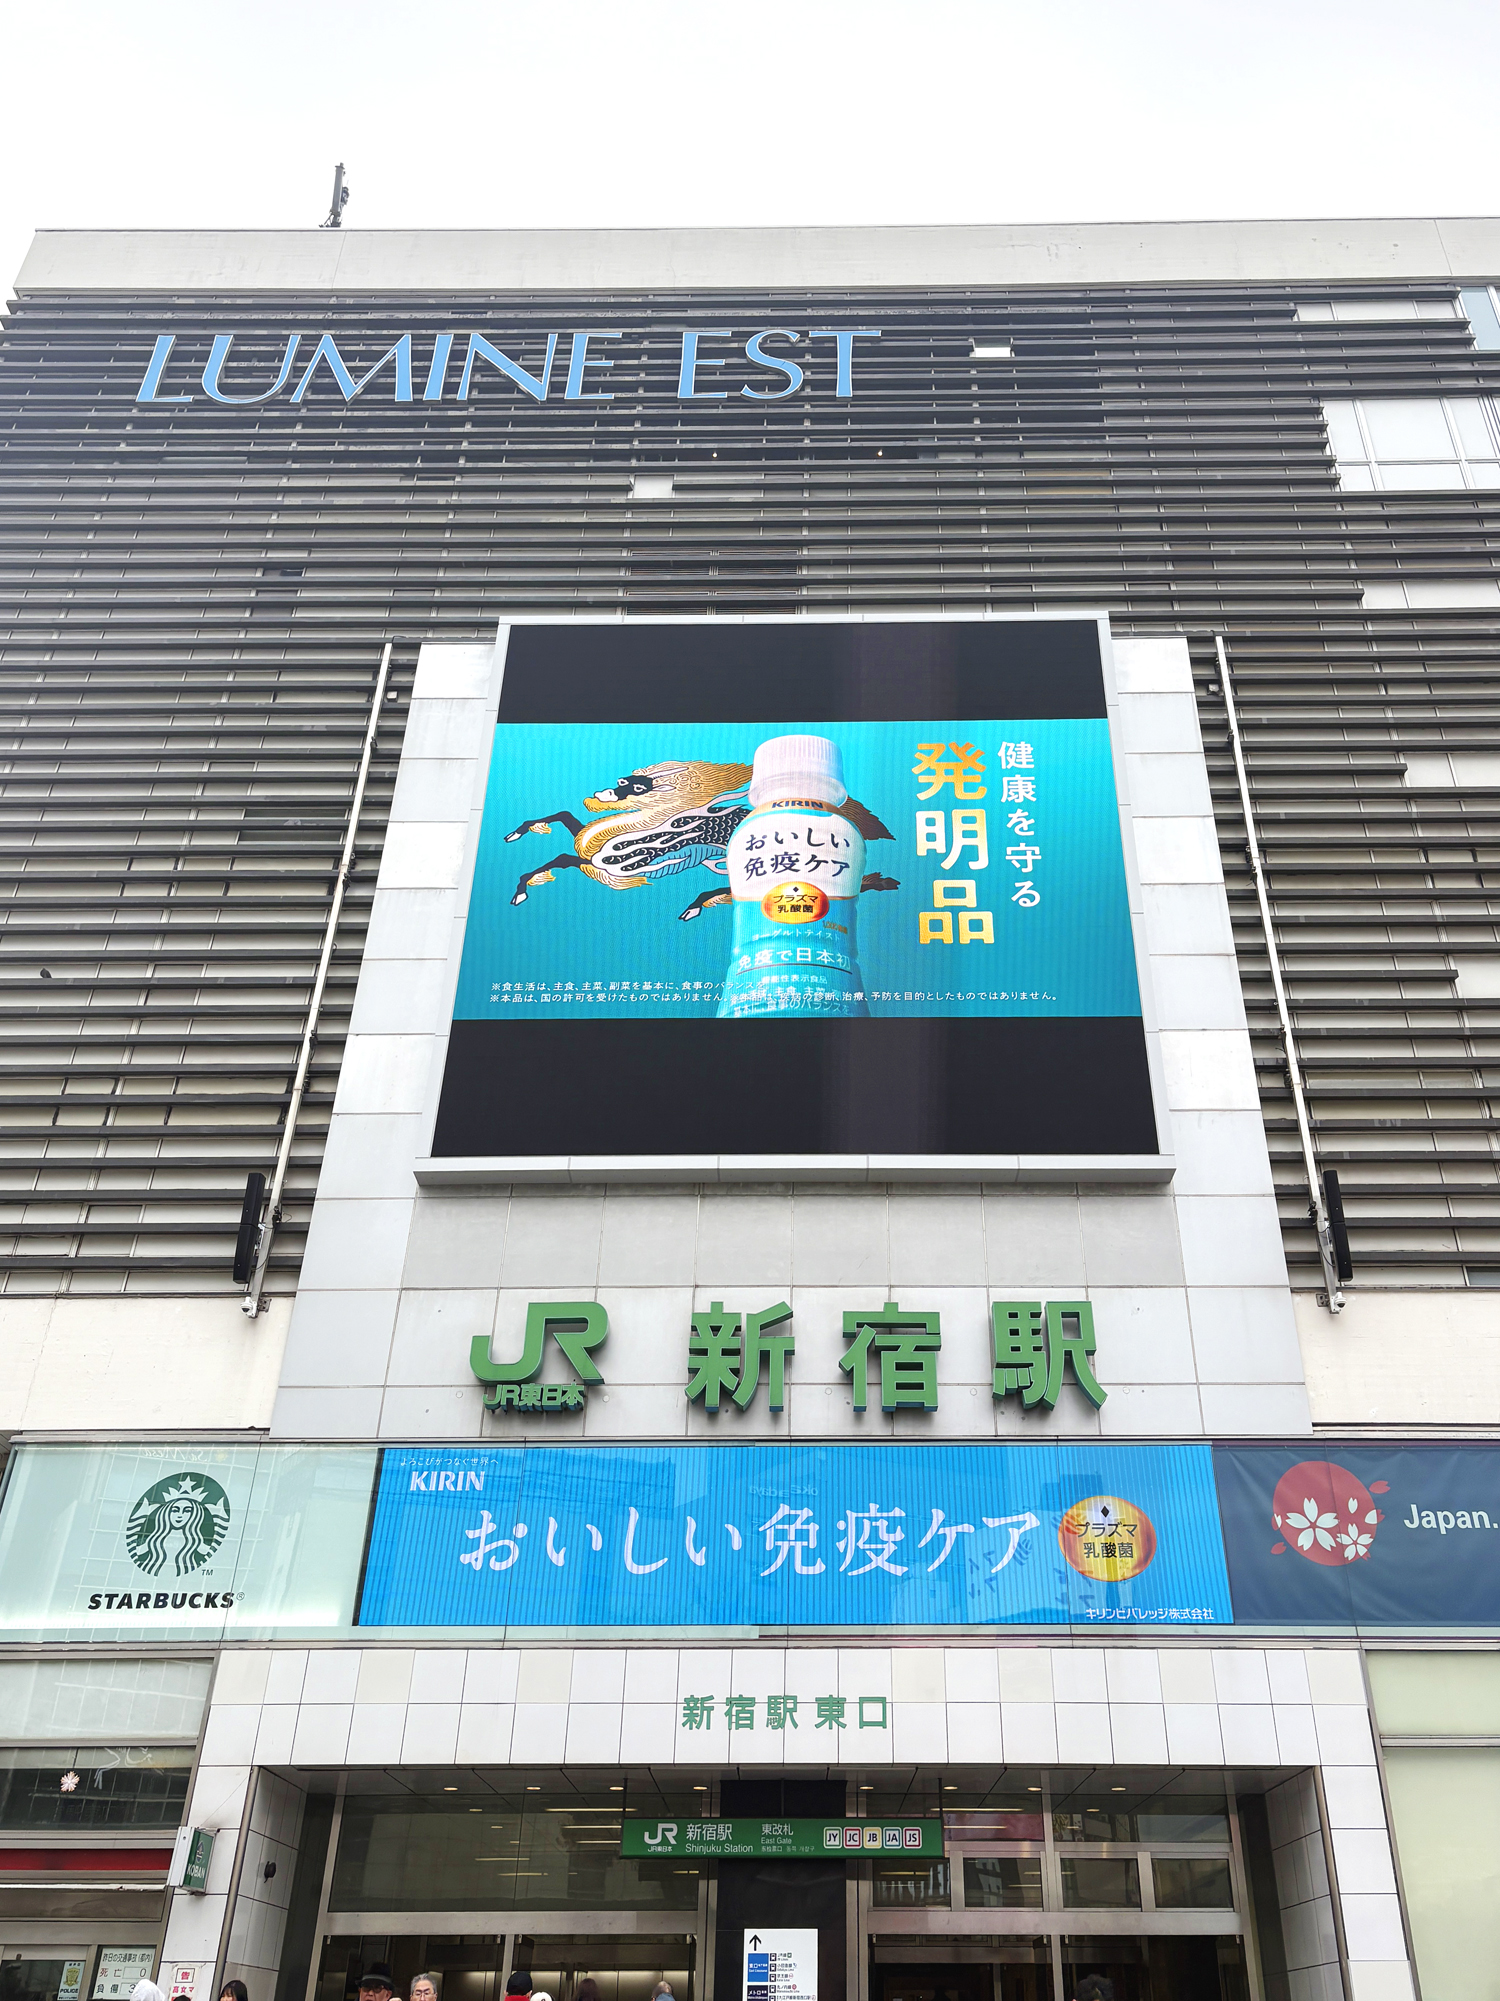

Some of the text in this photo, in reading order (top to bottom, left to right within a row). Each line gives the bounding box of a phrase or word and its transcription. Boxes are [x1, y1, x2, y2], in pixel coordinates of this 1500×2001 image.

[135, 329, 882, 405] LUMINE EST
[771, 800, 824, 809] KIRIN
[997, 741, 1042, 908] 健康を守る
[745, 827, 850, 851] おいしい
[911, 741, 995, 945] 発明品
[743, 851, 850, 882] 免疫ケア
[773, 894, 819, 903] プラズマ
[777, 904, 814, 914] 乳酸菌
[737, 947, 850, 971] 免疫で日本初
[469, 1301, 610, 1385] JR
[684, 1301, 1109, 1413] 新宿駅
[483, 1383, 587, 1413] JR東日本
[400, 1456, 499, 1467] よろこびがつなぐ世界へ
[410, 1471, 486, 1491] KIRIN
[1403, 1503, 1499, 1535] Japan.
[1077, 1521, 1138, 1539] プラズマ
[459, 1503, 1040, 1576] おいしい免疫ケア
[1083, 1541, 1135, 1560] 乳酸菌
[1085, 1607, 1215, 1620] キリンビバレッジ株式会社
[681, 1694, 888, 1731] 新宿駅東口
[644, 1823, 678, 1845] JR
[685, 1823, 733, 1841] 新宿駅
[761, 1823, 794, 1836] 東改札
[828, 1833, 838, 1843] JY
[848, 1833, 858, 1843] JC
[867, 1833, 878, 1843] JB
[887, 1833, 898, 1843] JA
[908, 1833, 917, 1843] JS
[685, 1843, 753, 1855] Shinjuku Station
[761, 1837, 792, 1845] East Gate
[187, 1863, 206, 1879] KOBAN
[139, 1968, 147, 1977] 0
